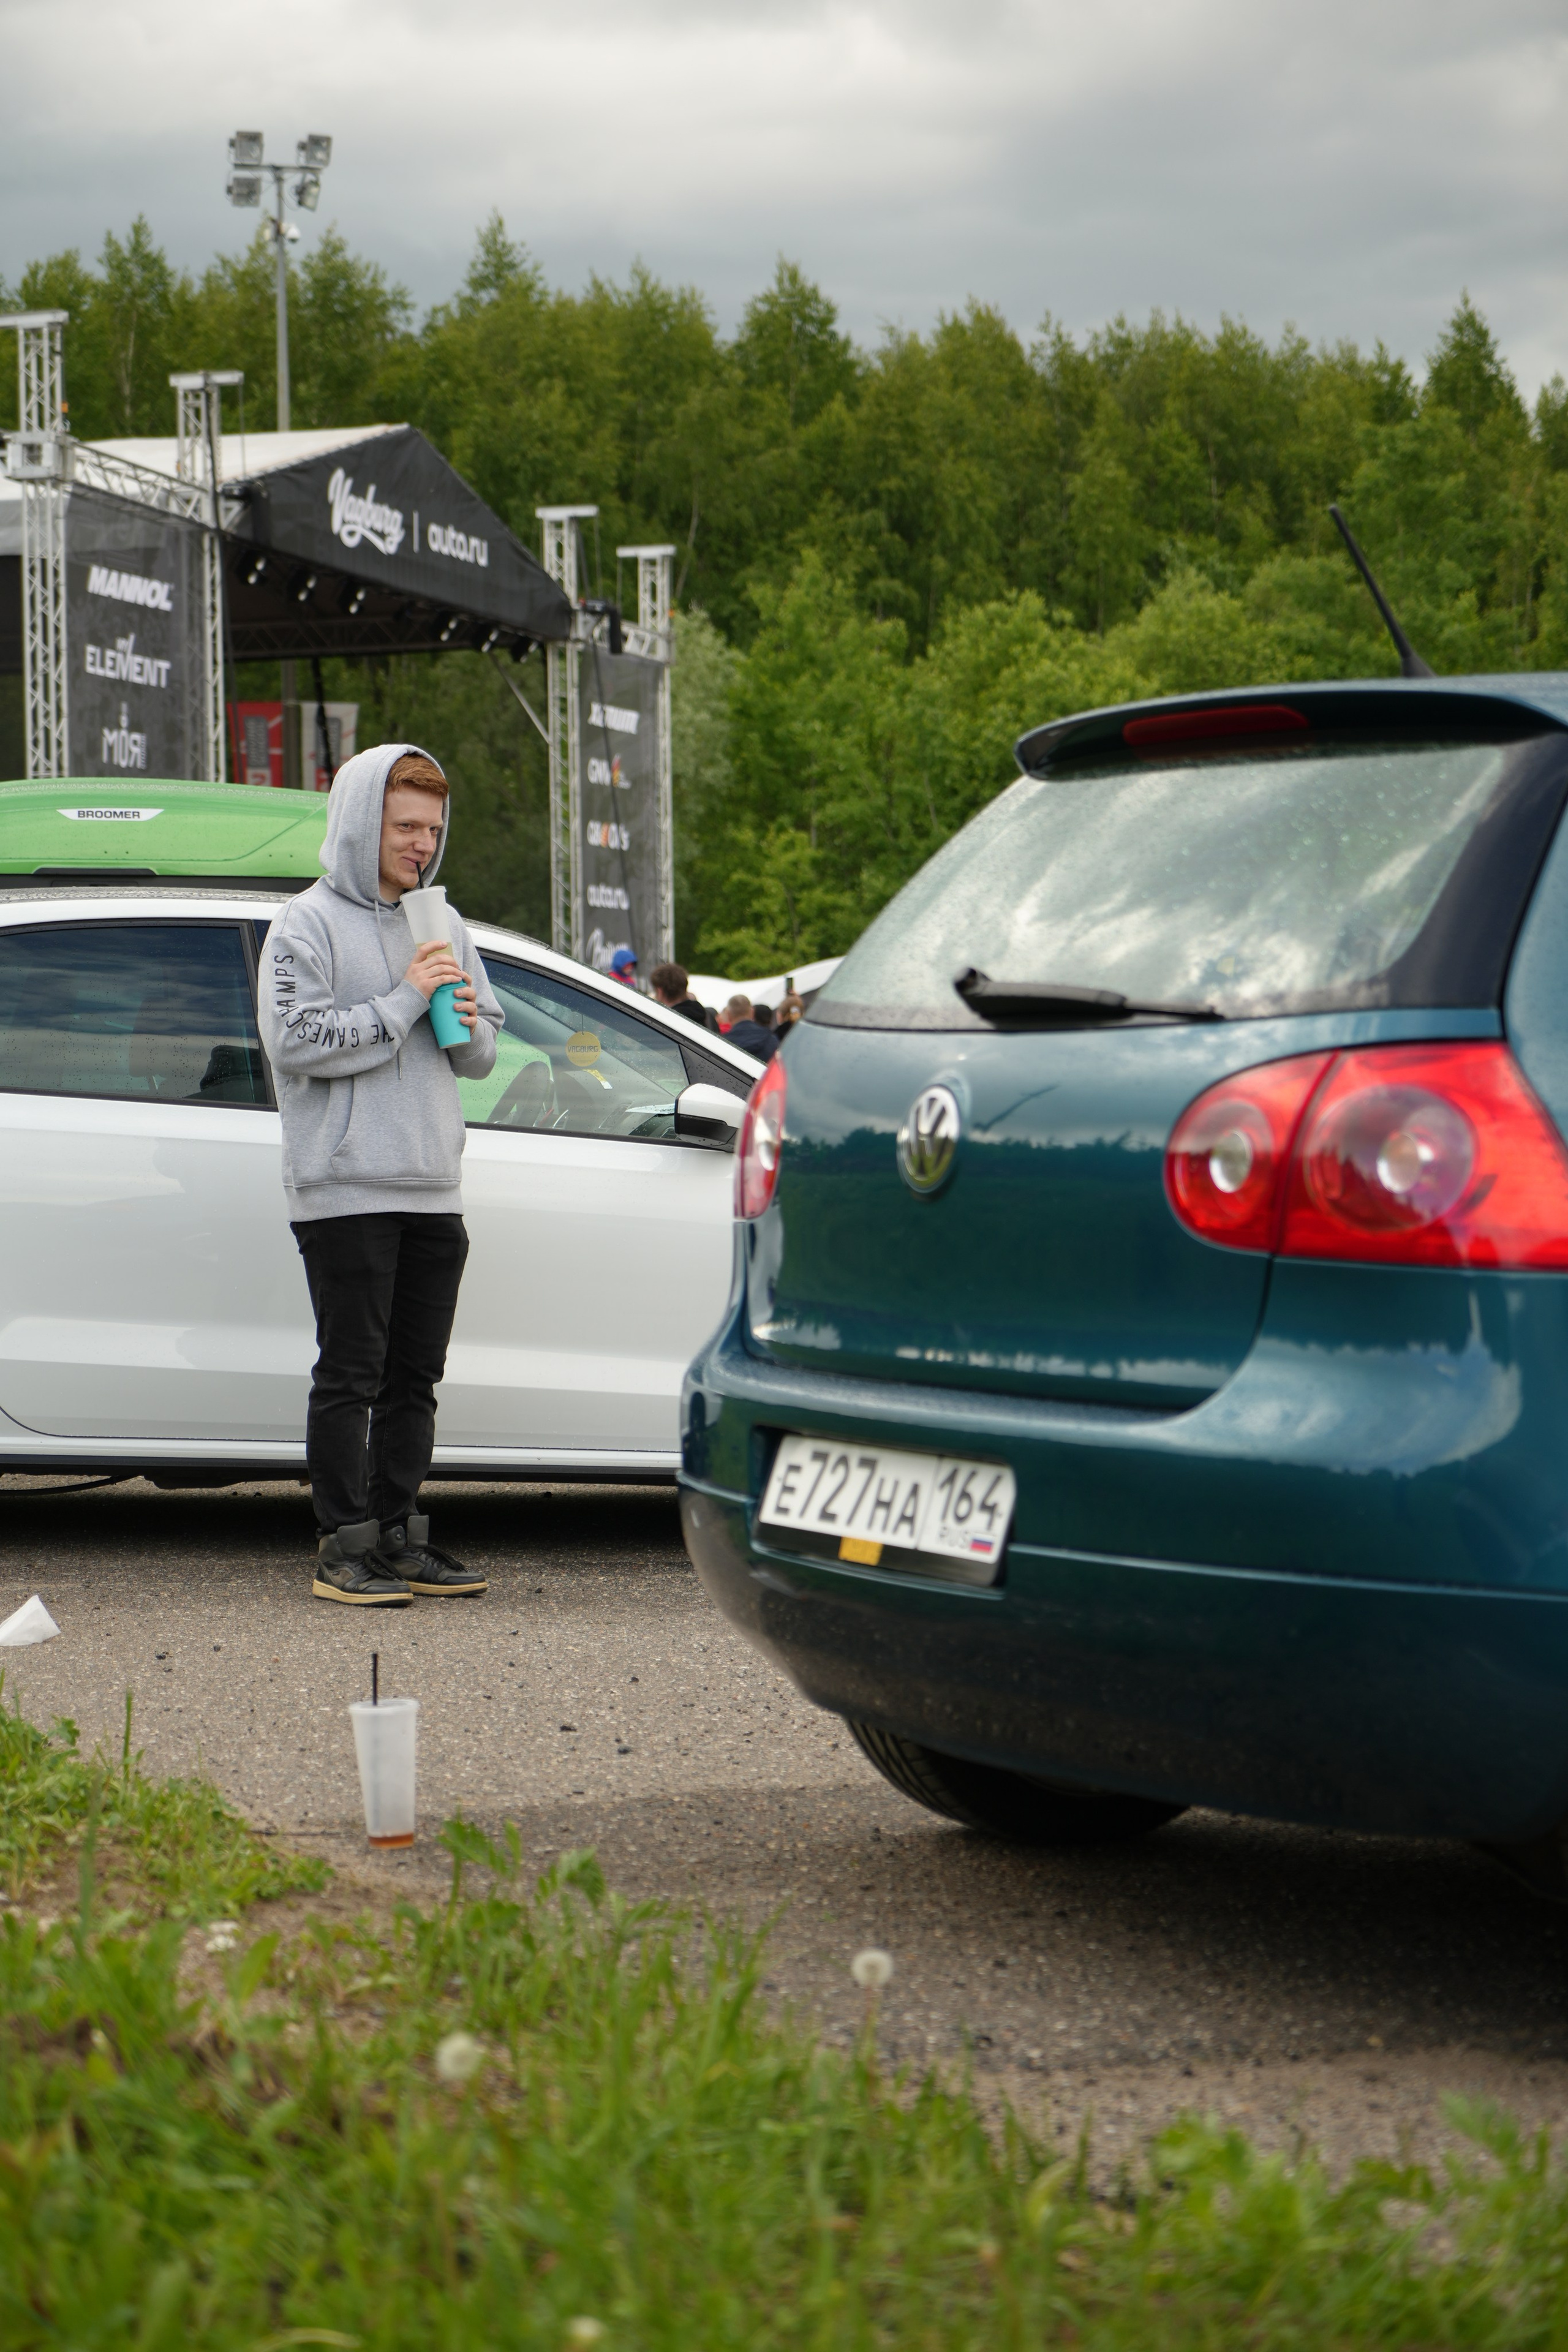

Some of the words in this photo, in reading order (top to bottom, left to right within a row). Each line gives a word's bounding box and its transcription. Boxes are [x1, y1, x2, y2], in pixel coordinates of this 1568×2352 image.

[427, 522, 489, 567] auto.ru
[87, 564, 173, 612] MANNOL
[85, 633, 172, 688] ELEMENT
[77, 810, 141, 820] BROOMER
[274, 955, 304, 1029] CHAMPS
[297, 1022, 360, 1049] GAMES
[938, 1467, 1003, 1531] 164
